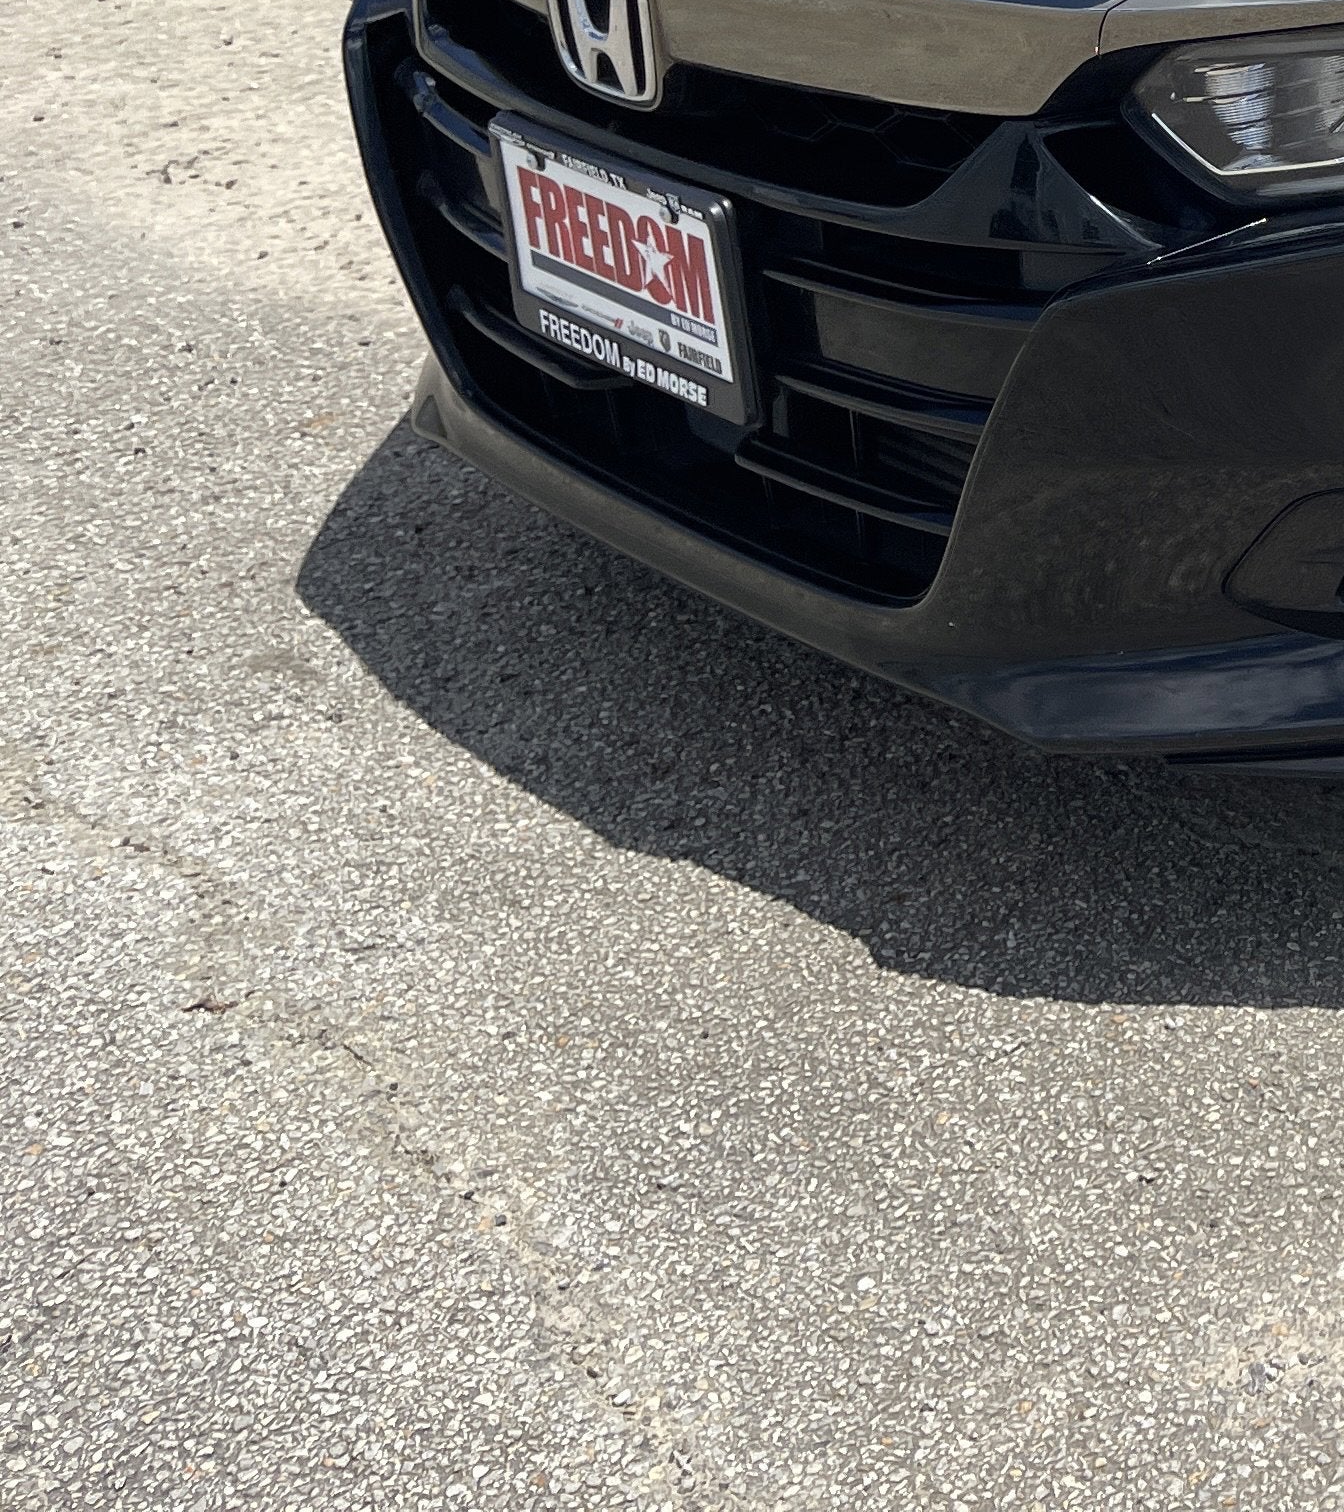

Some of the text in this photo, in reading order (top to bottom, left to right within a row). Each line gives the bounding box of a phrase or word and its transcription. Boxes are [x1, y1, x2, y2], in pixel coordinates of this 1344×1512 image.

[517, 165, 715, 325] FREEDOM
[538, 309, 621, 368] FREEDOM
[636, 358, 656, 384] ED
[656, 368, 708, 407] MORSE
